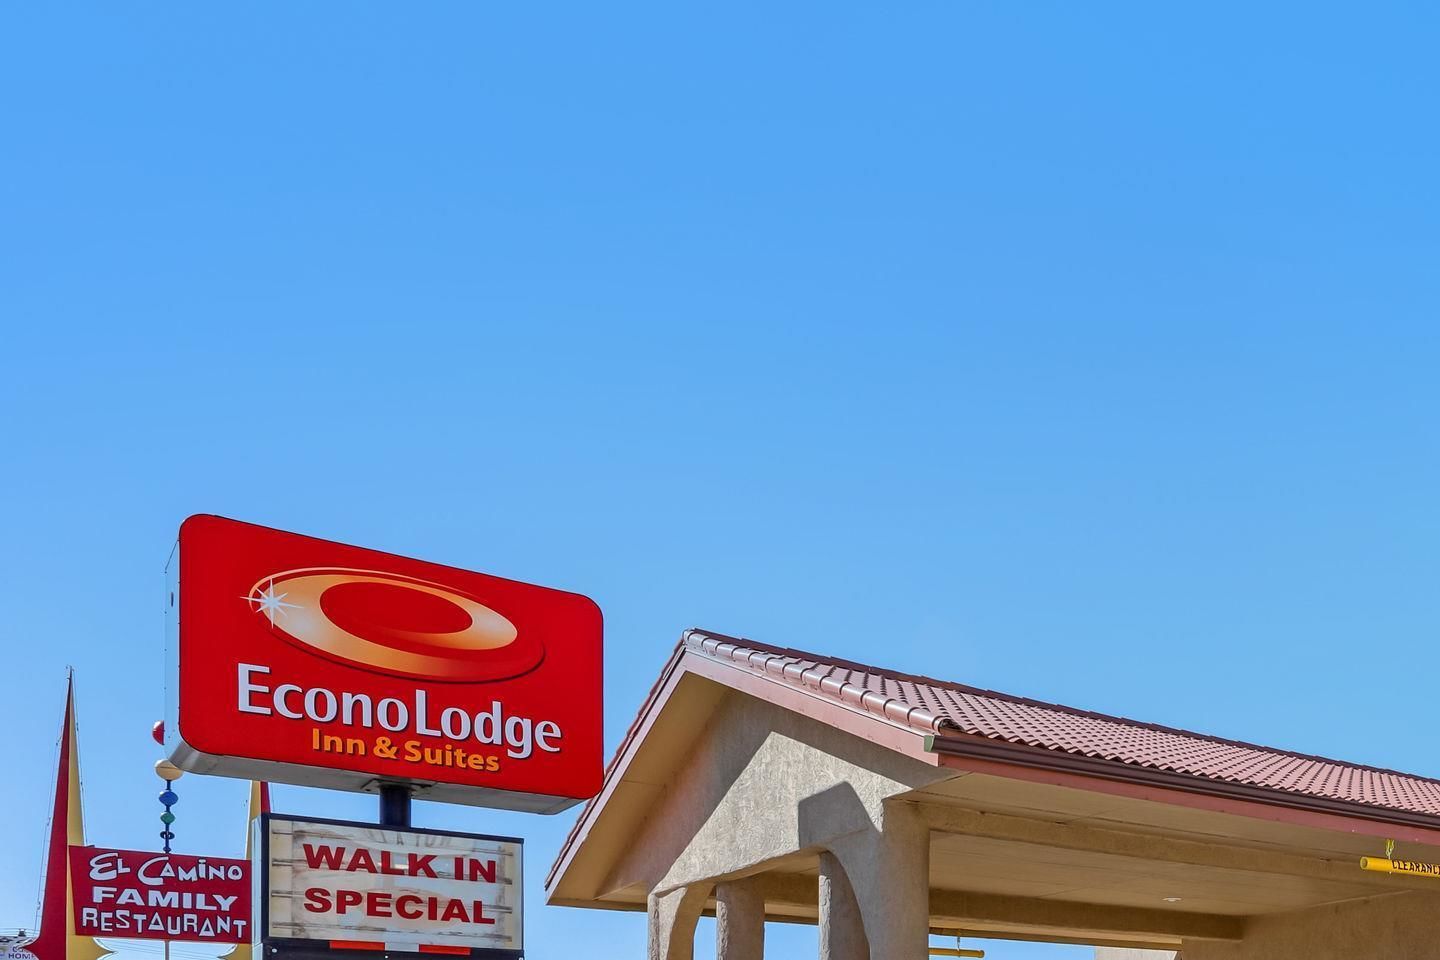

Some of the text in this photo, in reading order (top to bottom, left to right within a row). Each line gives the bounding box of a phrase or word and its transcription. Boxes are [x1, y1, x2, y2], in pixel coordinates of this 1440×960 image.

[311, 728, 500, 773] Inn & Suites
[302, 843, 497, 884] WALK IN
[92, 886, 239, 912] FAMILY
[303, 887, 497, 925] SPECIAL
[82, 907, 247, 938] RESTAURANT
